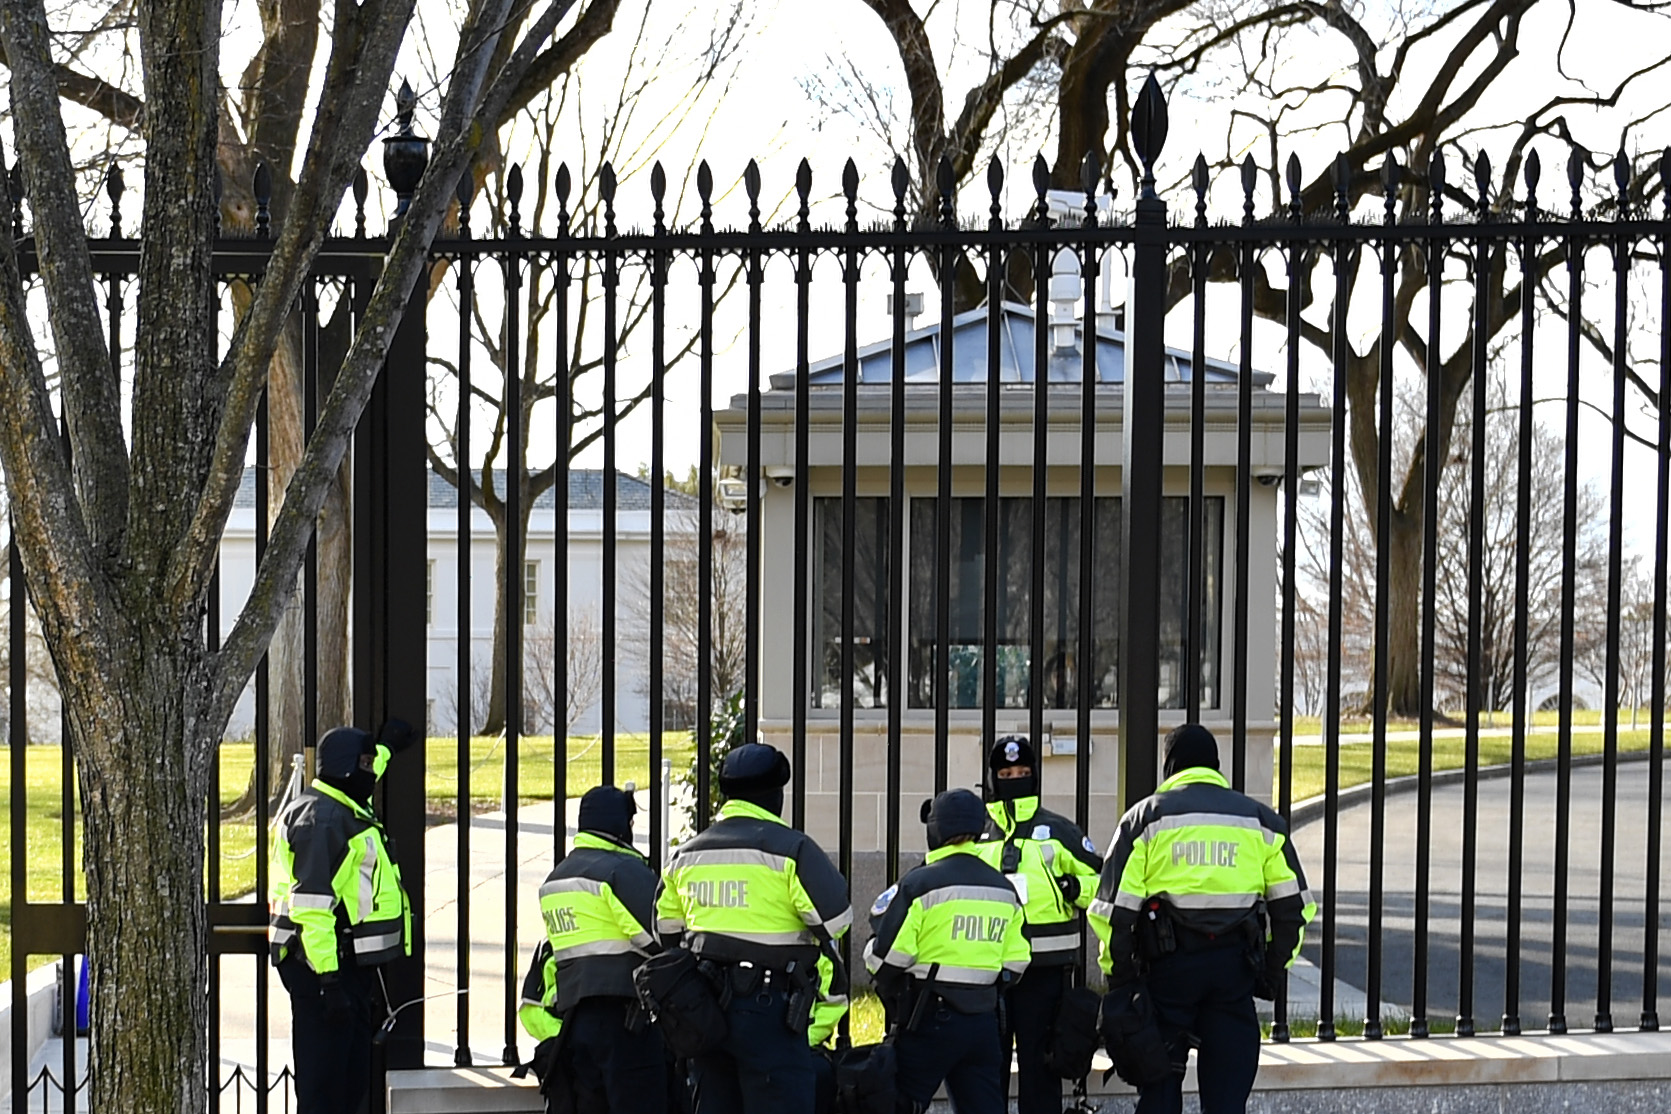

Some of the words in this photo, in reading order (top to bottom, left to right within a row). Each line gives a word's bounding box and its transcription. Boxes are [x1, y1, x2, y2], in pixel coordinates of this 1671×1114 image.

[1171, 840, 1240, 868] POLICE
[687, 879, 750, 908] POLICE
[950, 914, 1010, 944] POLICE
